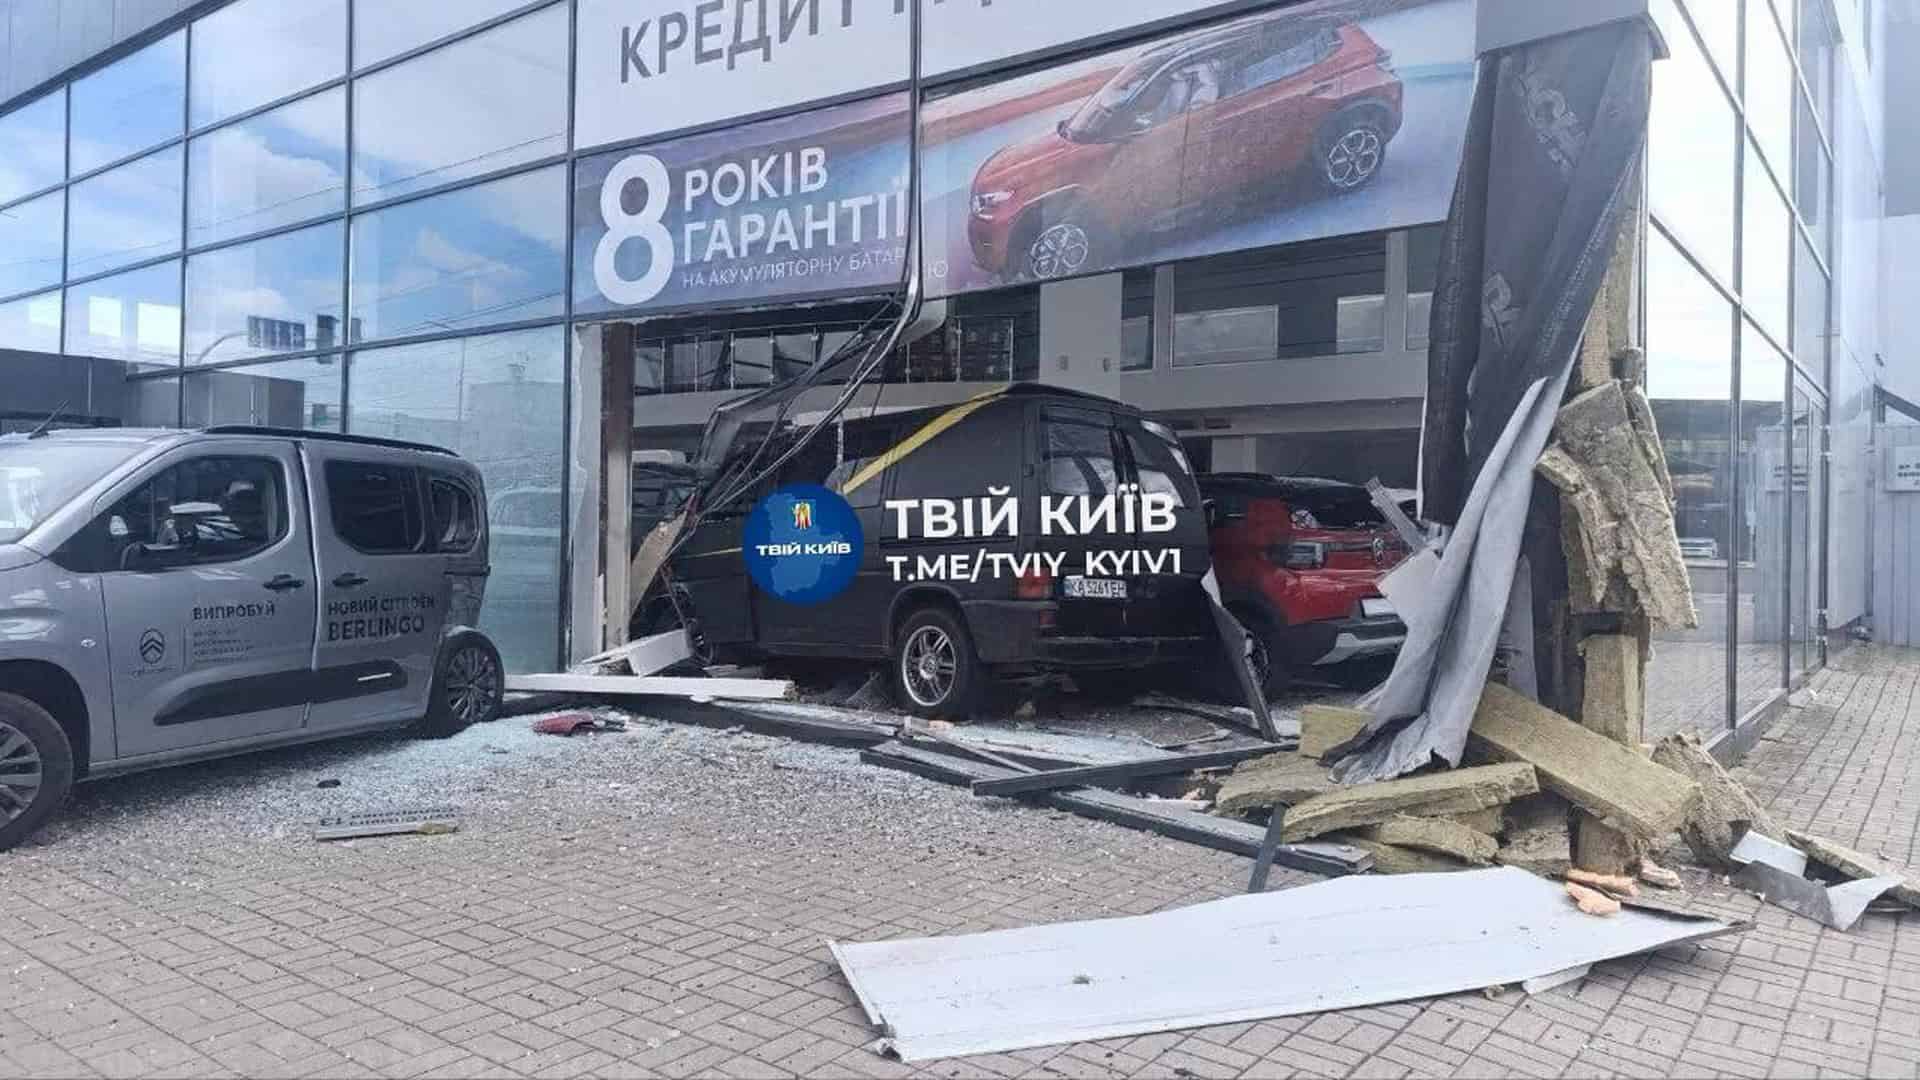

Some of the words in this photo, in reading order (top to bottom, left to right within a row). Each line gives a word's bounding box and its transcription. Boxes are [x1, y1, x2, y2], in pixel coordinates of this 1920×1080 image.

[593, 154, 675, 305] 8
[685, 147, 828, 212] РОКІВ
[684, 174, 907, 264] ГАРАНТІЇ
[683, 271, 706, 289] НА
[709, 255, 844, 287] АКУМУЛЯТОРНУ
[193, 601, 275, 620] ВИПРОБУЙ
[328, 595, 378, 615] НОВИЙ
[328, 615, 425, 641] BERLINGO
